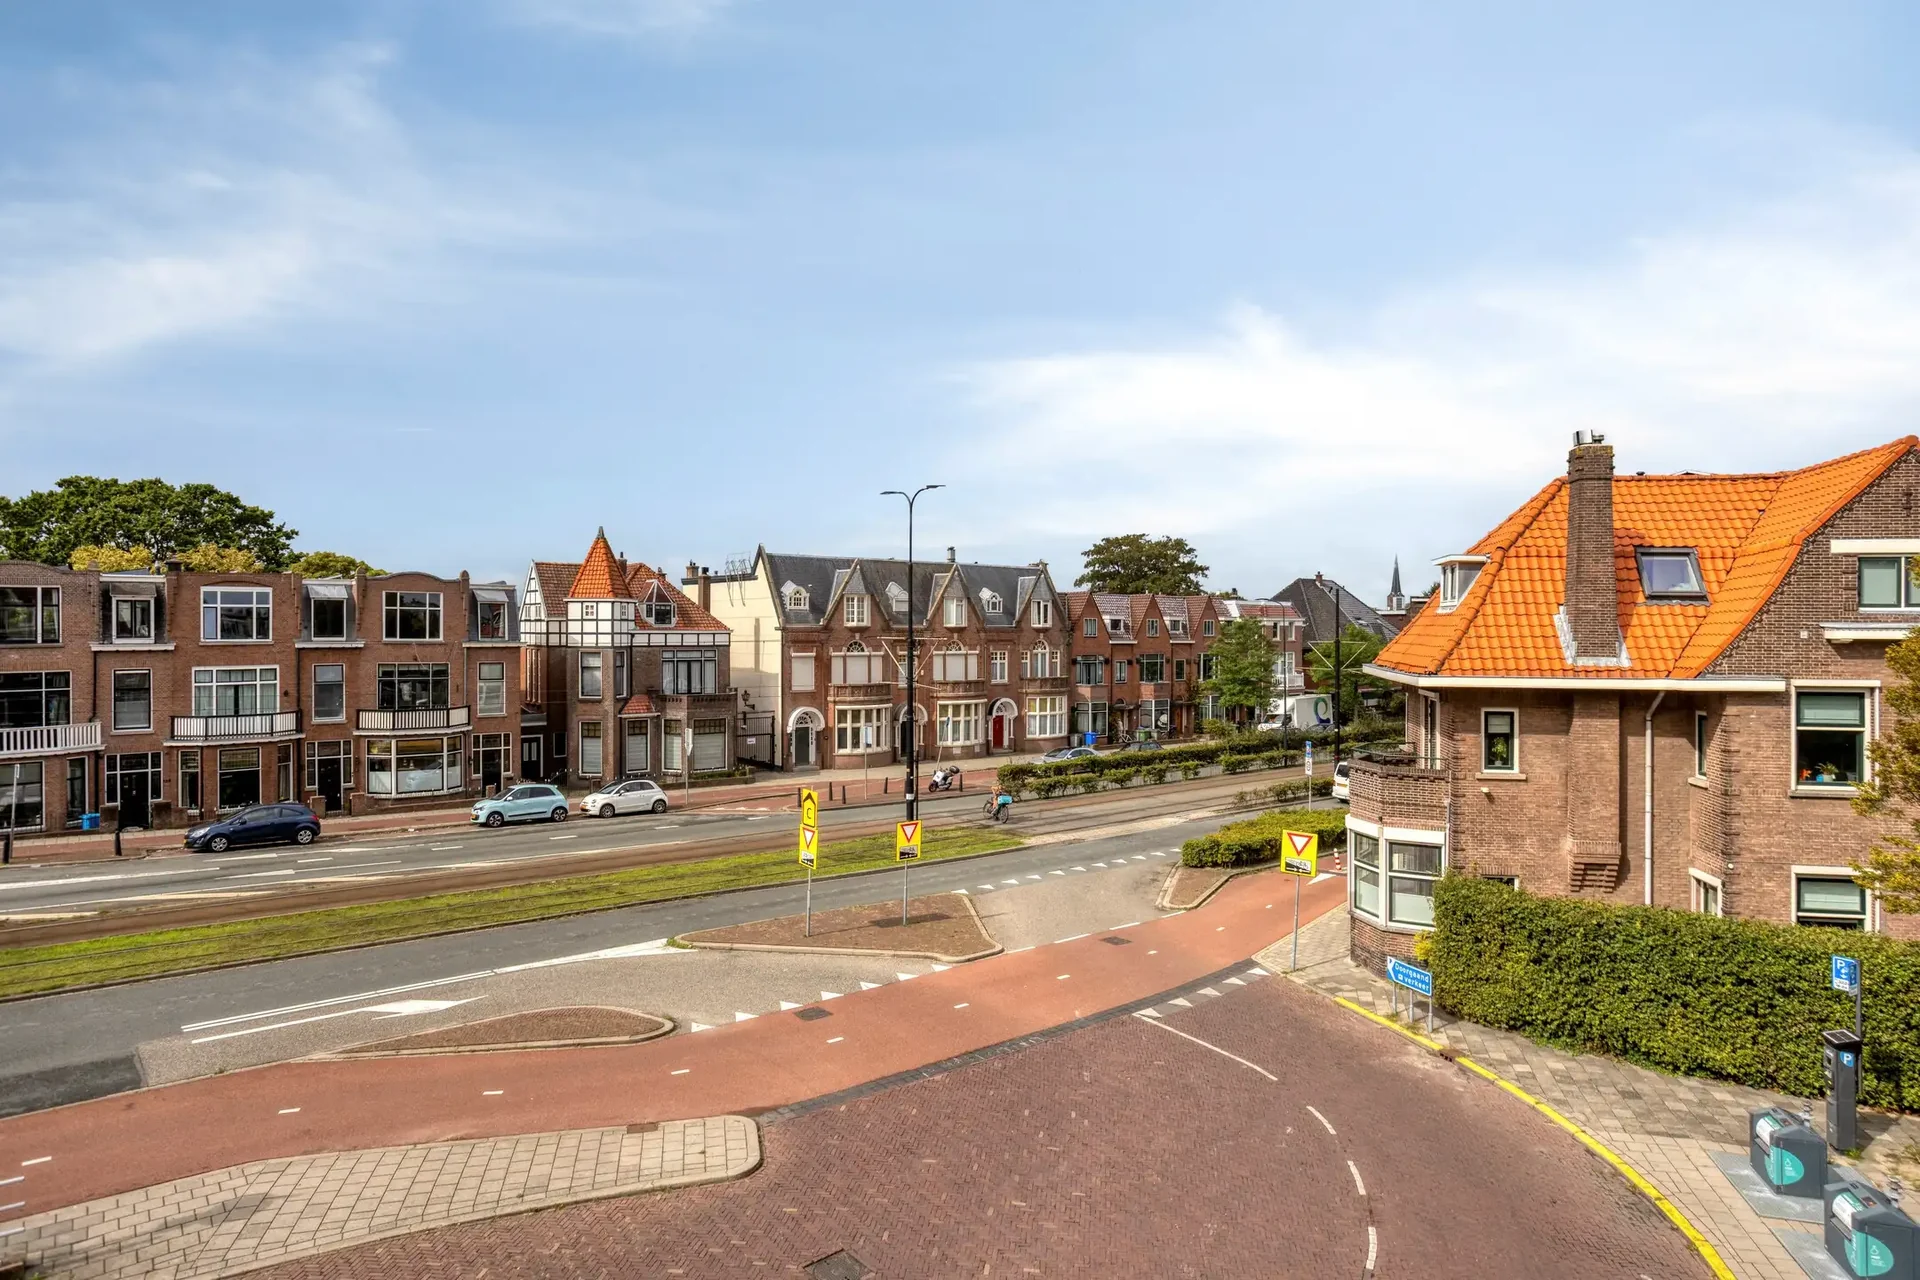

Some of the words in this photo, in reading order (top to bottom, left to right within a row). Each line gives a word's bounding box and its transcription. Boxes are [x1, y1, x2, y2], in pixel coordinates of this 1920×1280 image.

[806, 807, 812, 820] C
[1837, 960, 1846, 970] P
[1395, 963, 1429, 983] Doorgaand
[1404, 976, 1429, 992] verkeer
[1843, 1053, 1852, 1065] P
